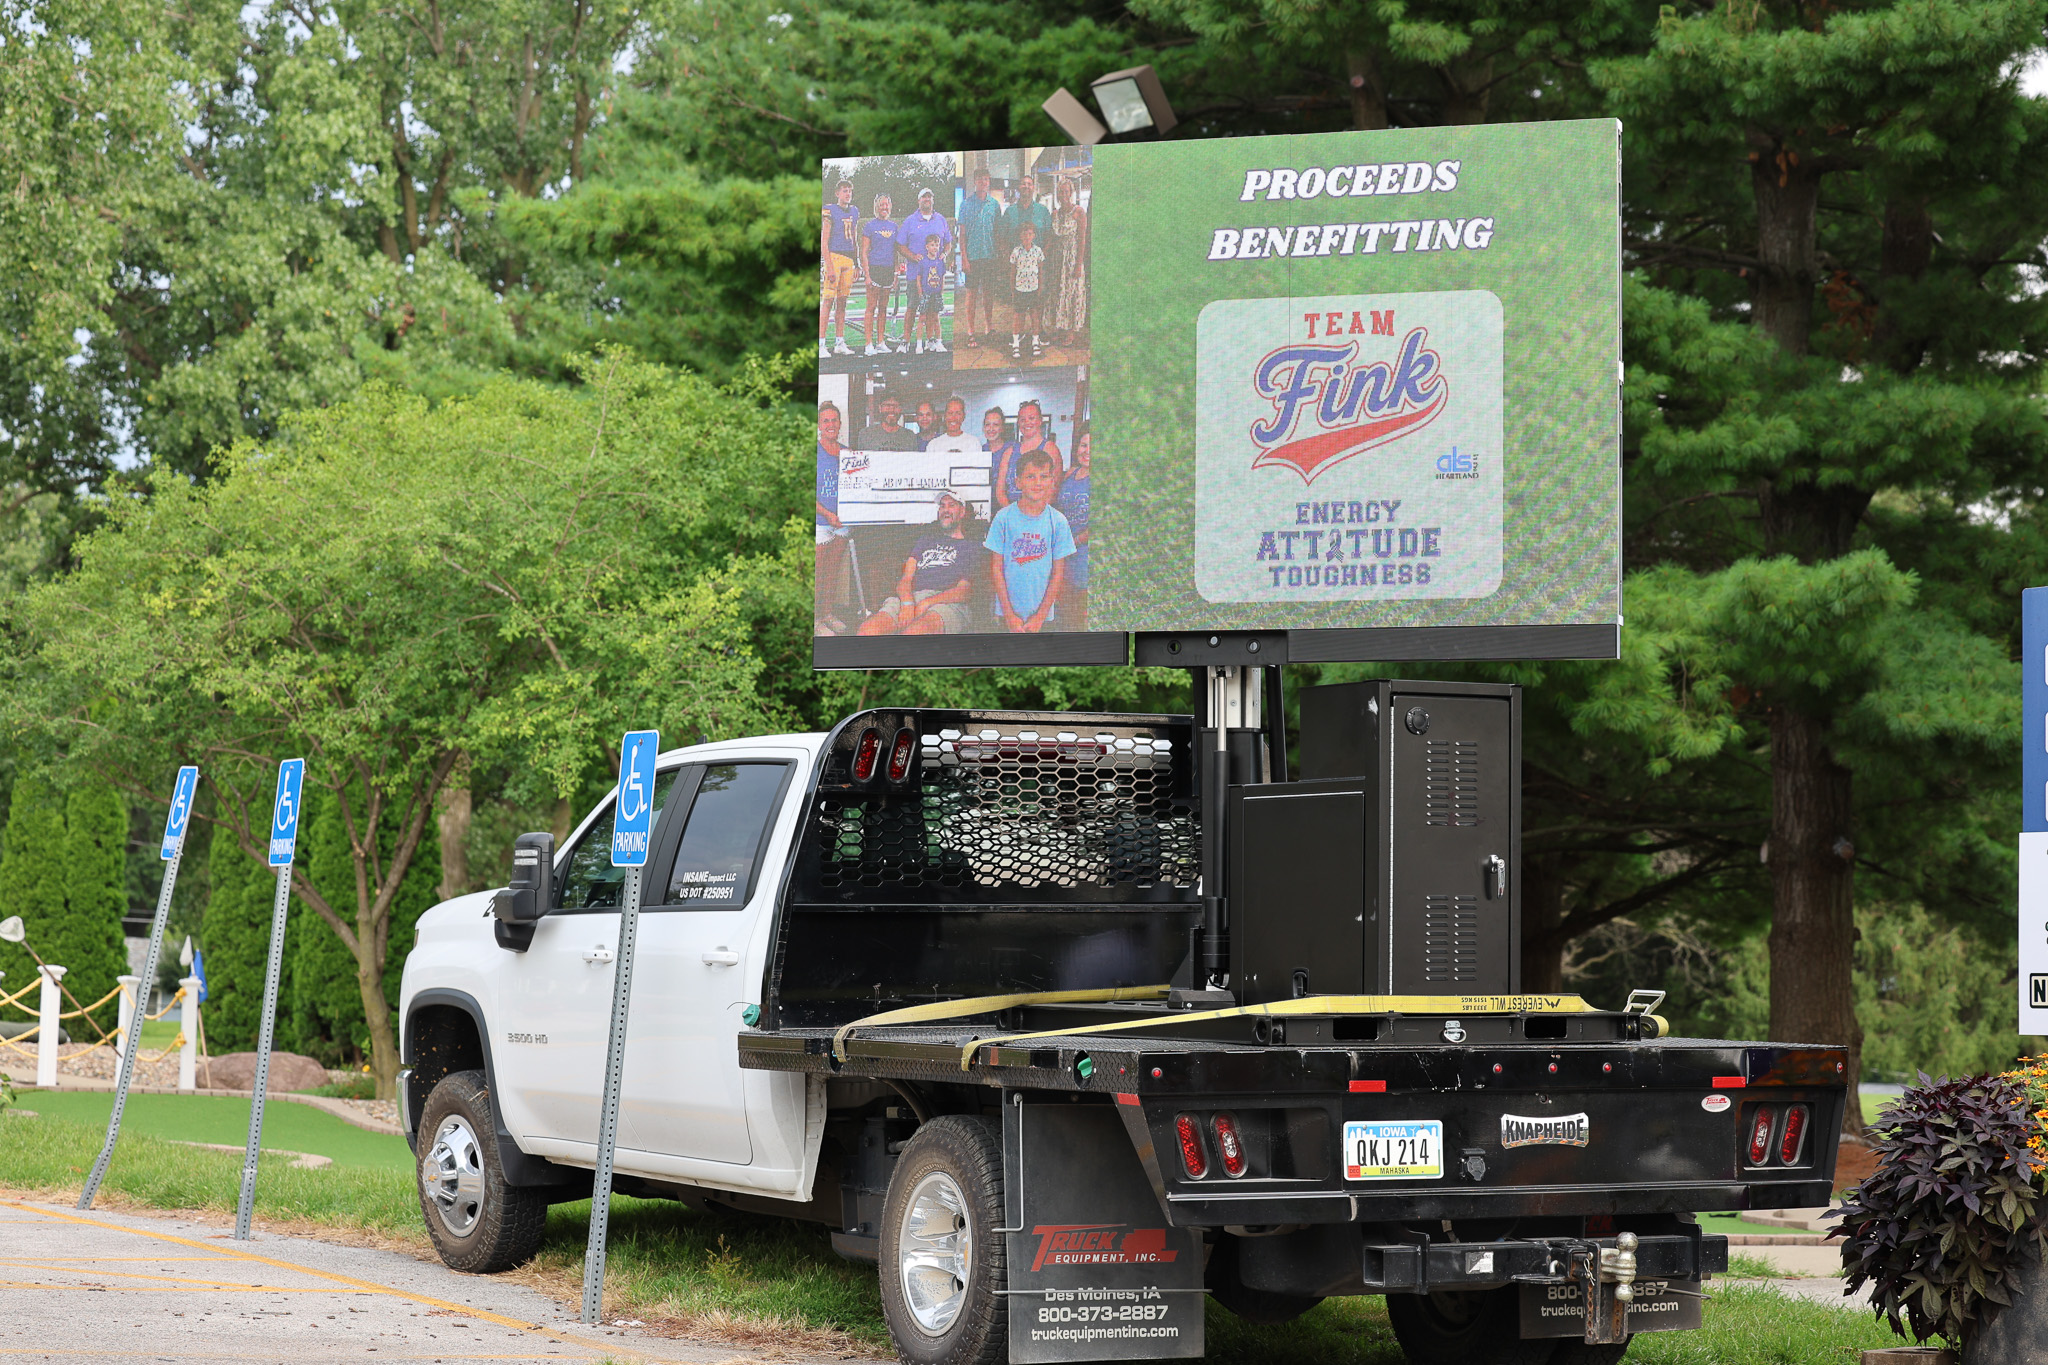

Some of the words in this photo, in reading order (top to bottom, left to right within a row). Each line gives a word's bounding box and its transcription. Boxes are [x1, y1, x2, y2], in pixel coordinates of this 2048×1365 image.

[1239, 160, 1461, 202] PROCEEDS
[1208, 217, 1494, 260] BENEFITTING
[1304, 310, 1395, 339] TEAM
[1251, 328, 1446, 444] Fink
[1296, 500, 1402, 525] ENERGY
[1269, 562, 1431, 588] TOUGHNESS
[271, 838, 293, 855] PARKING
[615, 831, 647, 852] PARKING
[683, 871, 709, 883] INSANE
[708, 874, 726, 884] impact
[725, 873, 737, 882] LLC
[680, 887, 689, 899] US
[689, 887, 703, 898] DOT
[703, 886, 734, 899] #250951
[1490, 997, 1506, 1010] WLL
[1508, 997, 1543, 1010] EVEREST
[507, 1032, 533, 1043] 3500
[534, 1034, 548, 1044] HD
[1380, 1126, 1408, 1137] IOWA
[1506, 1118, 1585, 1142] KNAPHEIDE
[1357, 1139, 1390, 1167] QKJ
[1398, 1138, 1429, 1165] 214
[1379, 1167, 1410, 1175] MAHASKA
[1055, 1253, 1129, 1263] EQUIPMENT,
[1135, 1253, 1161, 1262] INC.
[1045, 1288, 1075, 1302] Des
[1077, 1287, 1140, 1302] Moines,
[1038, 1305, 1169, 1323] 800-373-2887
[1031, 1325, 1179, 1343] truckequipmentinc.com
